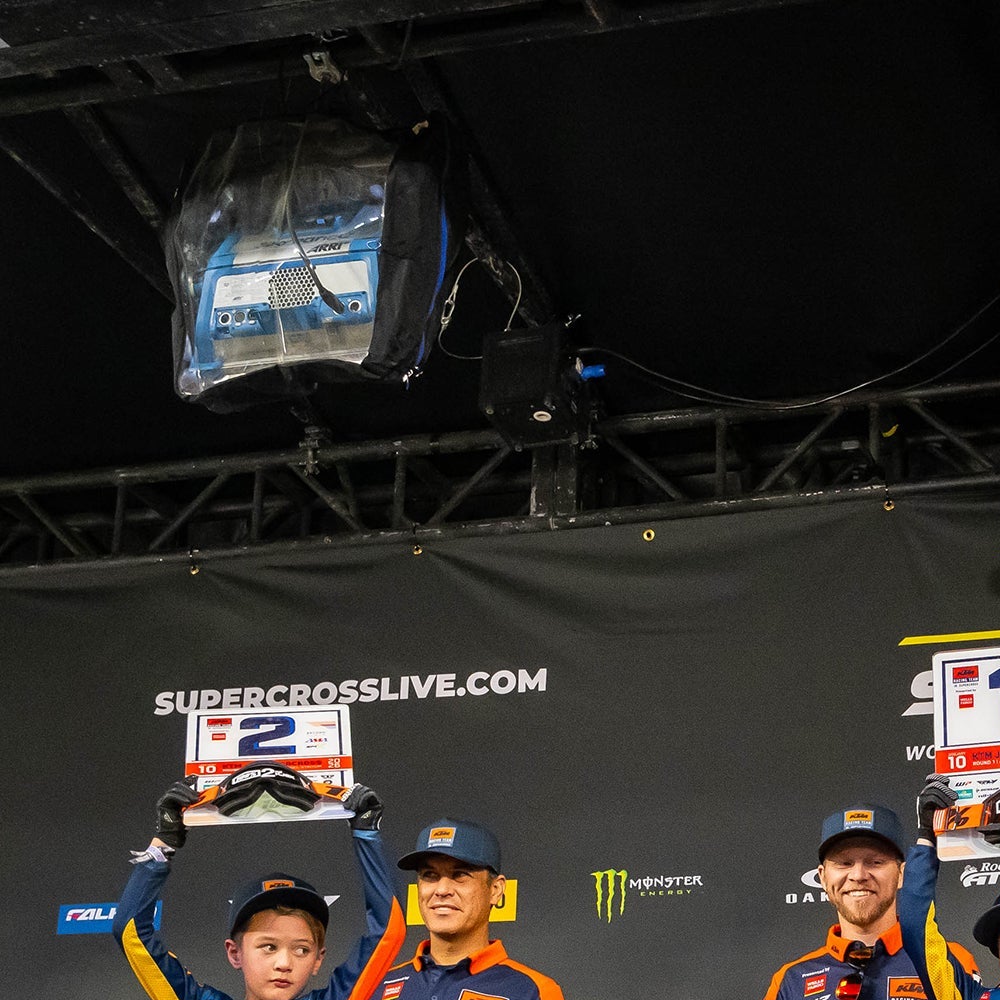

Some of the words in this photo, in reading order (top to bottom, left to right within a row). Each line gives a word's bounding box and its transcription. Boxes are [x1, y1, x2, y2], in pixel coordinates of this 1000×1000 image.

[306, 242, 343, 253] ARRI
[154, 668, 547, 715] SUPERCROSSLIVE.COM
[238, 716, 296, 757] 2
[972, 751, 993, 760] KTM
[947, 756, 967, 769] 10
[198, 765, 217, 774] 10
[260, 768, 275, 778] 2
[629, 874, 703, 889] MONSTER
[640, 889, 693, 897] ENERGY
[785, 893, 830, 904] OAK
